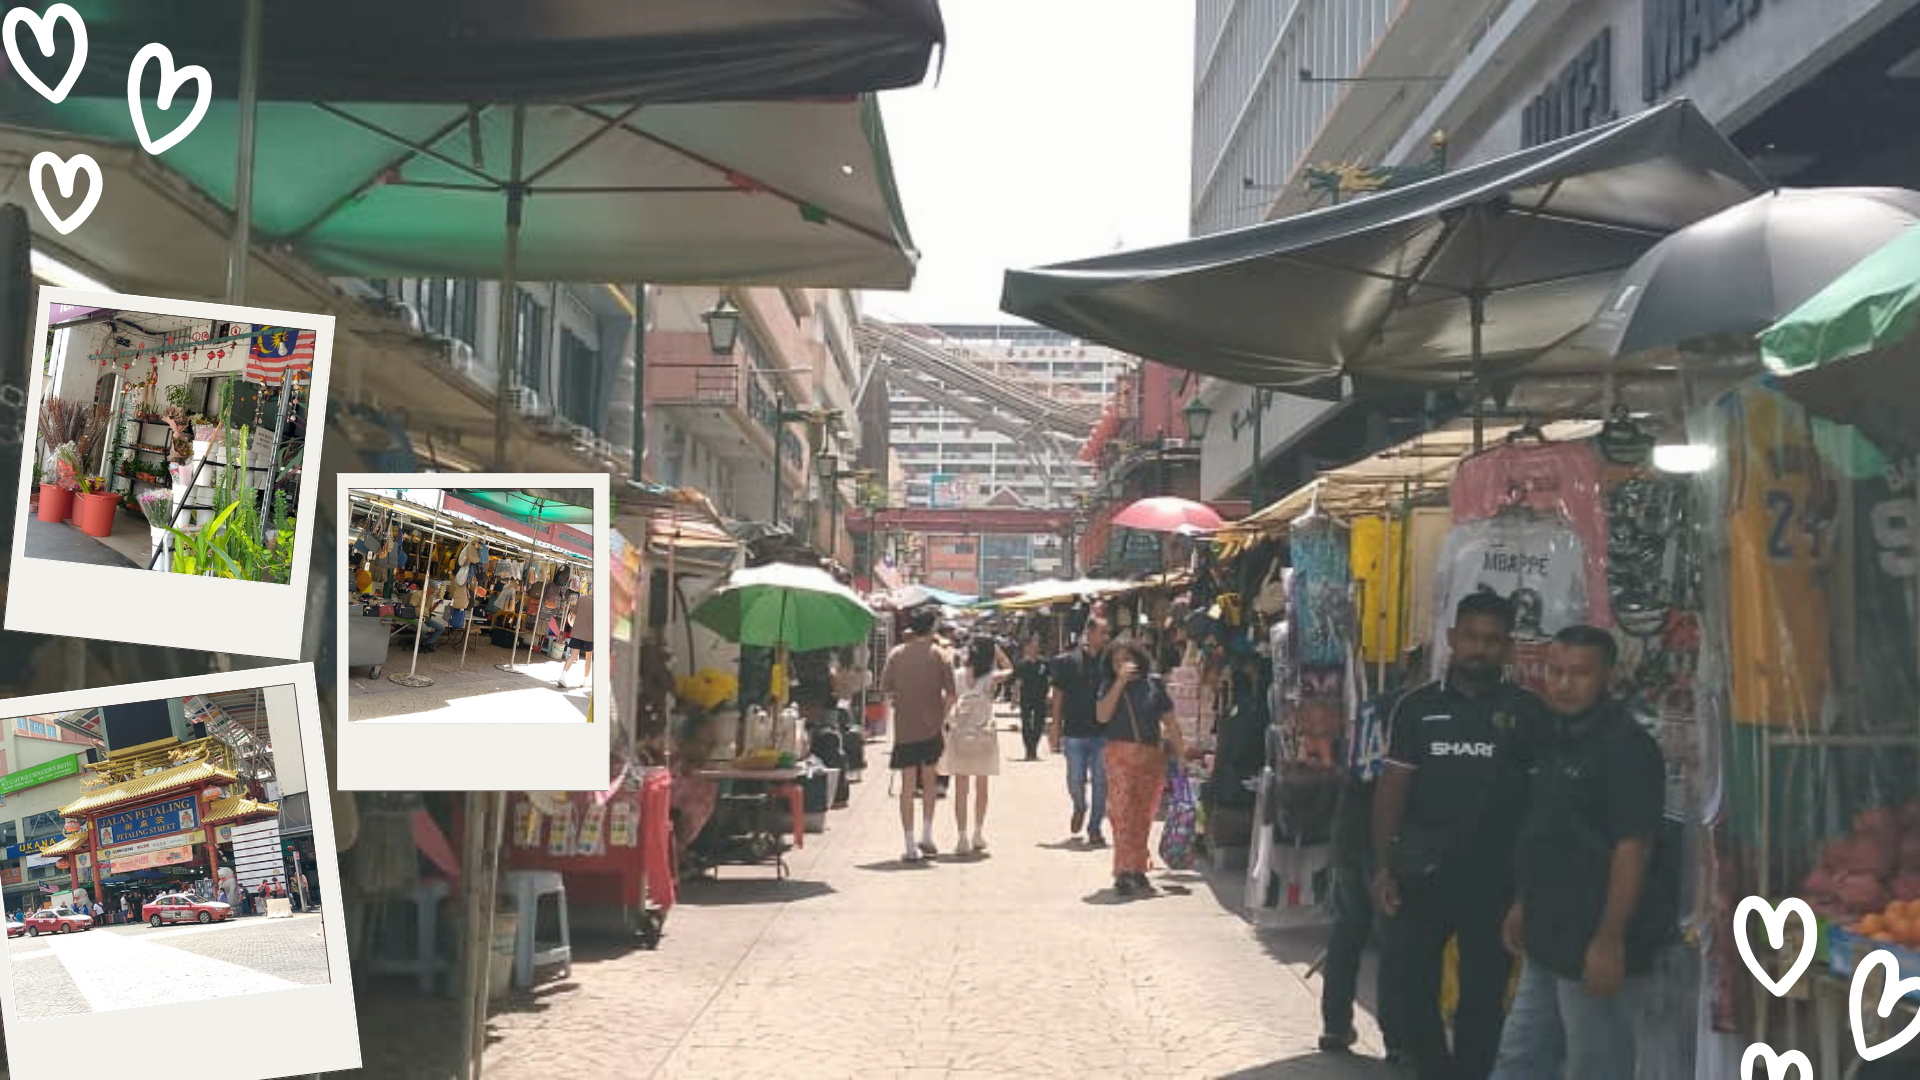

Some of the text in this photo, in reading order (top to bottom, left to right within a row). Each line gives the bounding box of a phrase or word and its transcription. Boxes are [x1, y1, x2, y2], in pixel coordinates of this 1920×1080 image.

[101, 799, 191, 828] JALAN PETALING
[116, 822, 176, 841] PETALING STREET
[19, 837, 56, 852] UKANA
